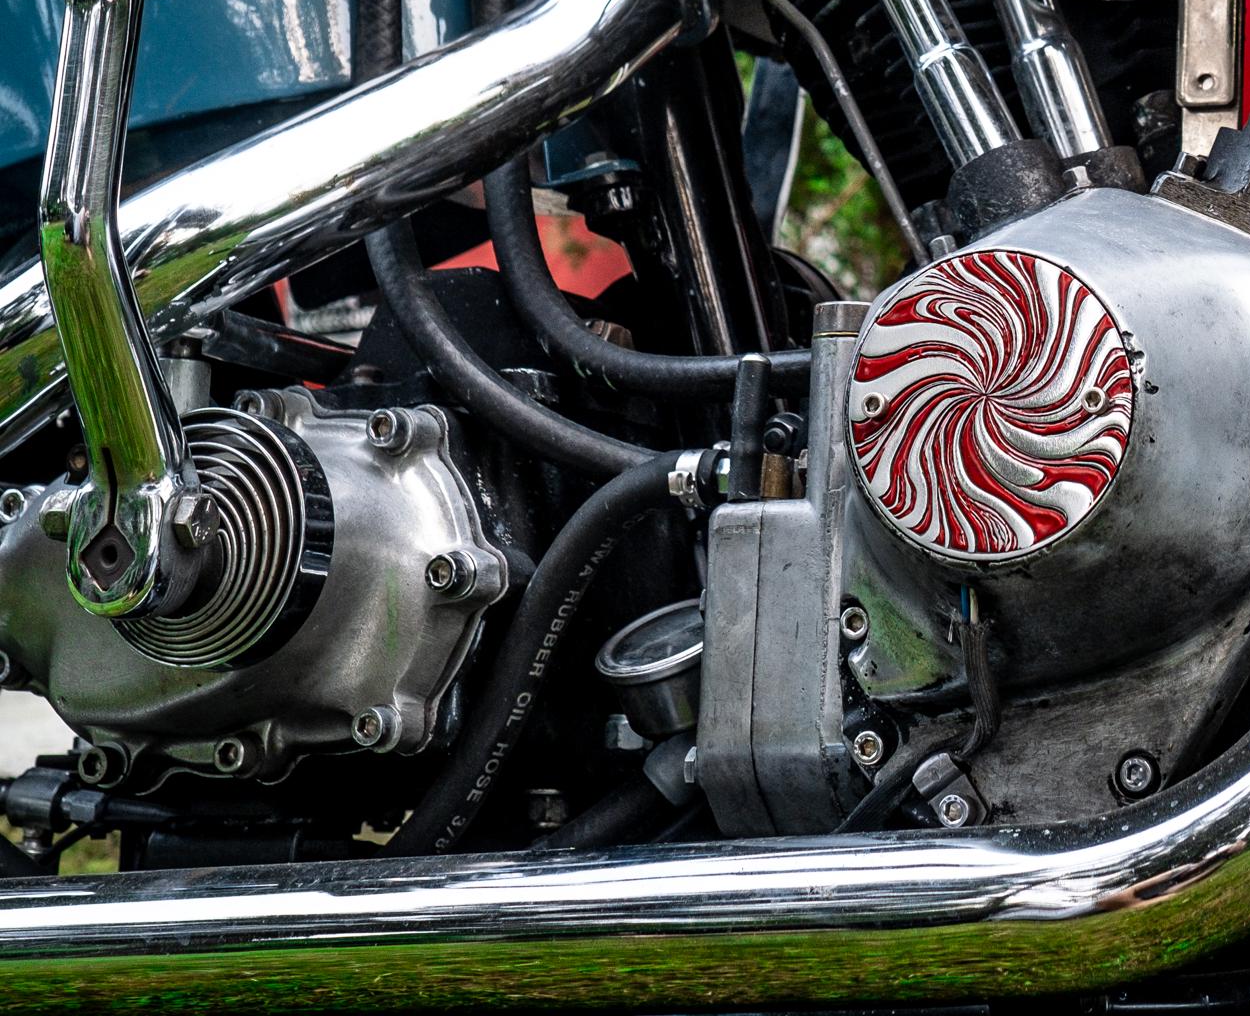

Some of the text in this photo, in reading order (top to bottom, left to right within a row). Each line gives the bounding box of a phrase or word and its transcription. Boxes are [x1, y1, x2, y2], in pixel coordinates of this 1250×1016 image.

[528, 589, 580, 677] RUBBER
[506, 691, 532, 728] OIL
[466, 742, 509, 802] HOSE
